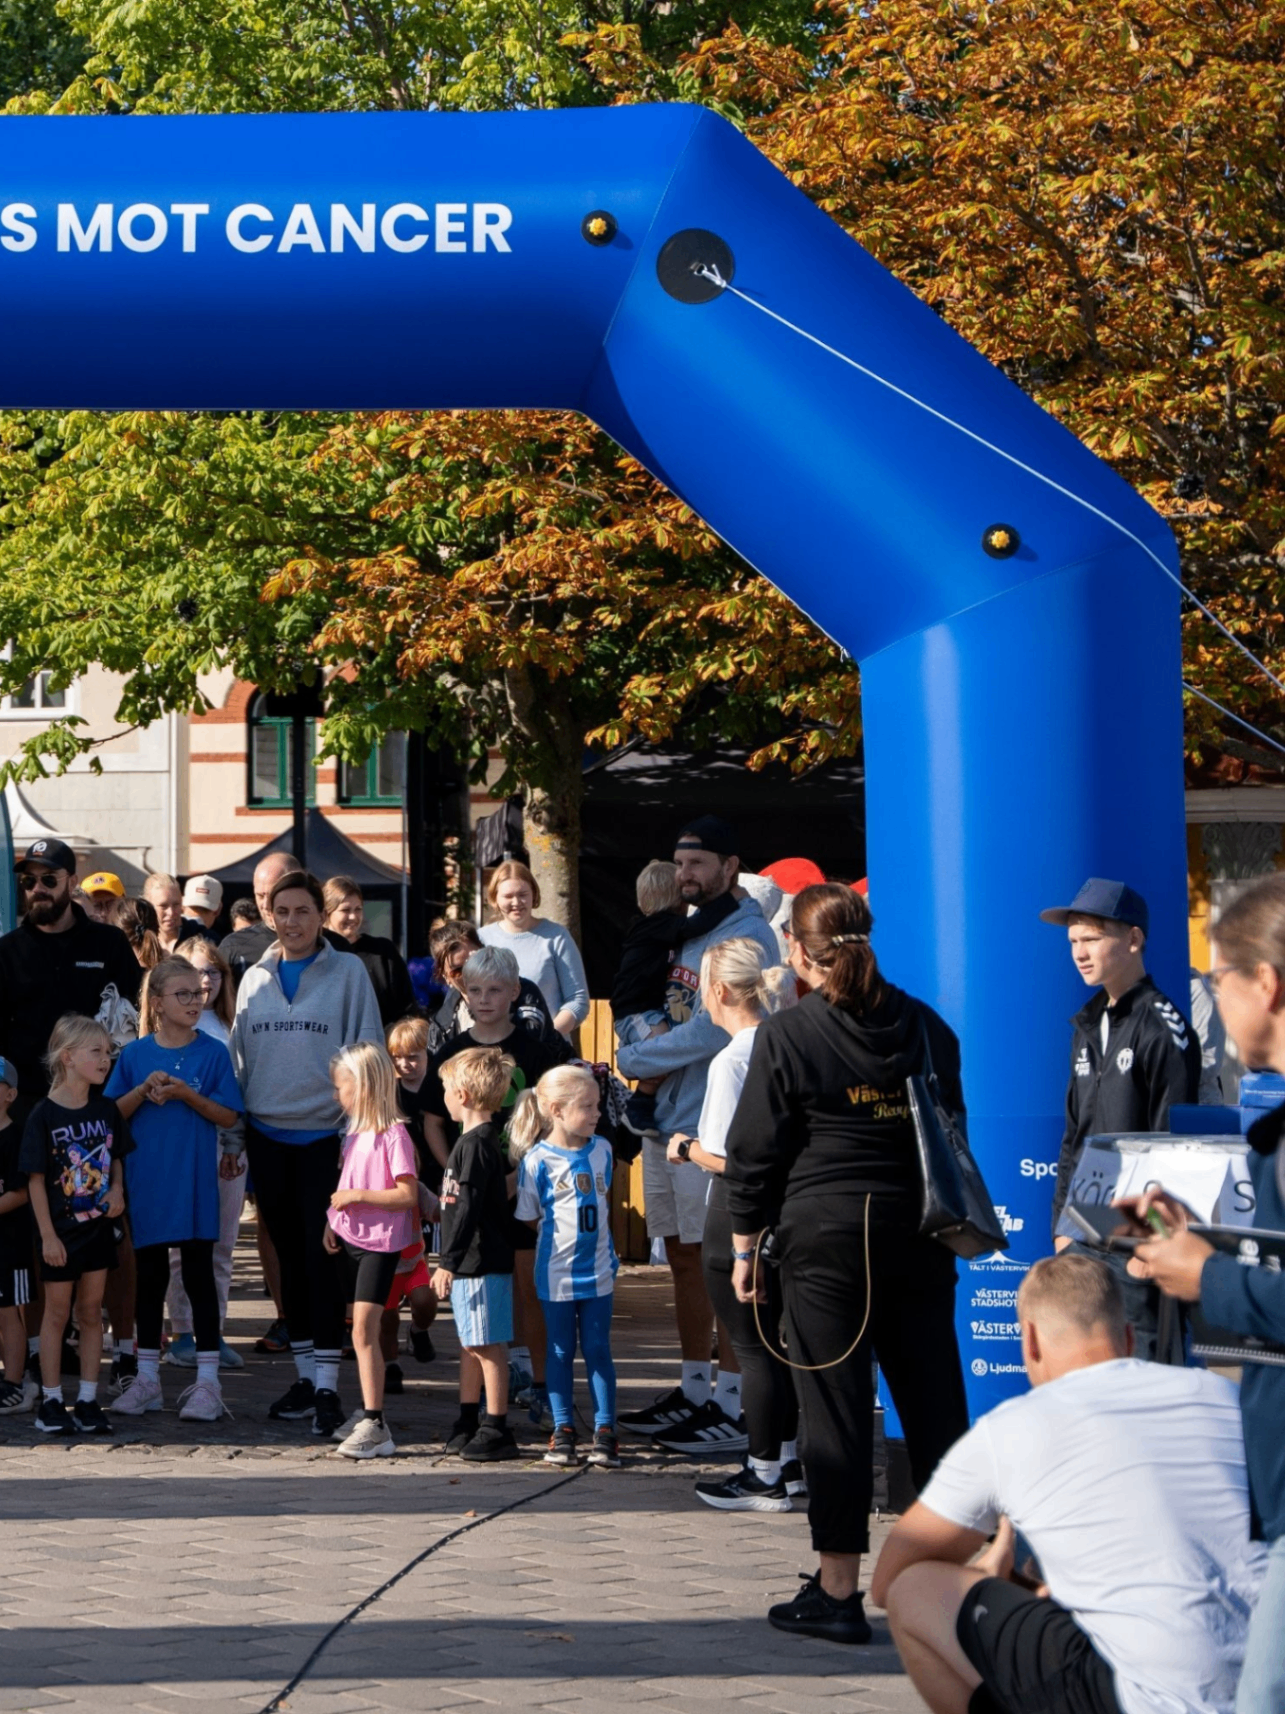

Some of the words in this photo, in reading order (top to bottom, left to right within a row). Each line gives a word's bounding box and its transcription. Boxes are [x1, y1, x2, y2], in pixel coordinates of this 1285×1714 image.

[57, 203, 209, 254] MOT
[225, 203, 513, 254] CANCER
[274, 1020, 329, 1035] SPORTSWEAR
[1020, 1158, 1059, 1181] Spo
[578, 1205, 598, 1233] 10
[975, 1288, 1018, 1298] VÄSTERVI
[971, 1298, 1017, 1307] STADSHOT
[970, 1320, 1022, 1335] VÄSTERV
[989, 1362, 1027, 1374] Ljudma
